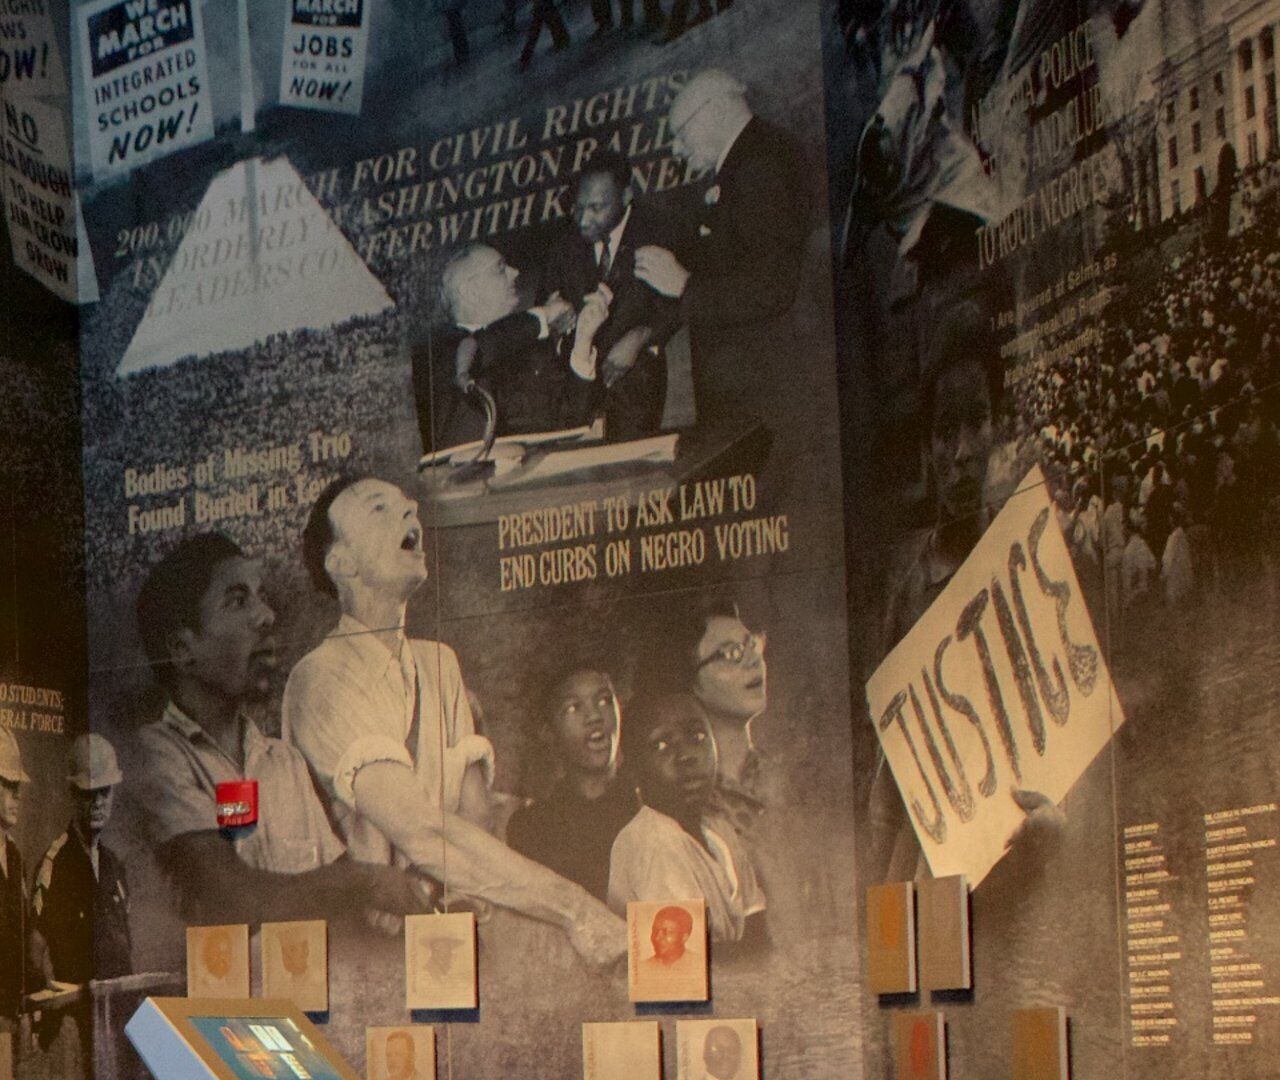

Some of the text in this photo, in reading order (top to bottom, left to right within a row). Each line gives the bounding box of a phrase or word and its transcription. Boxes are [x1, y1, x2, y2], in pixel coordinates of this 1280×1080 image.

[98, 4, 188, 60] MARCH
[293, 34, 353, 58] JOBS
[94, 48, 196, 106] INTEGRATED
[97, 76, 200, 132] SCHOOLS
[289, 75, 353, 102] NOW!
[108, 101, 199, 165] NOW!
[352, 147, 418, 193] FOR
[429, 116, 529, 170] CIVIL
[543, 70, 690, 141] RIGHTS
[439, 195, 536, 246] WITH
[125, 428, 353, 498] Bodies of Missing Trio
[128, 496, 186, 535] Found
[194, 484, 262, 523] Buried
[498, 473, 756, 550] PRESIDENT TO ASK LAW TO
[500, 515, 790, 593] END CURBS ON NEGRO VOTING
[30, 713, 66, 734] FORCE
